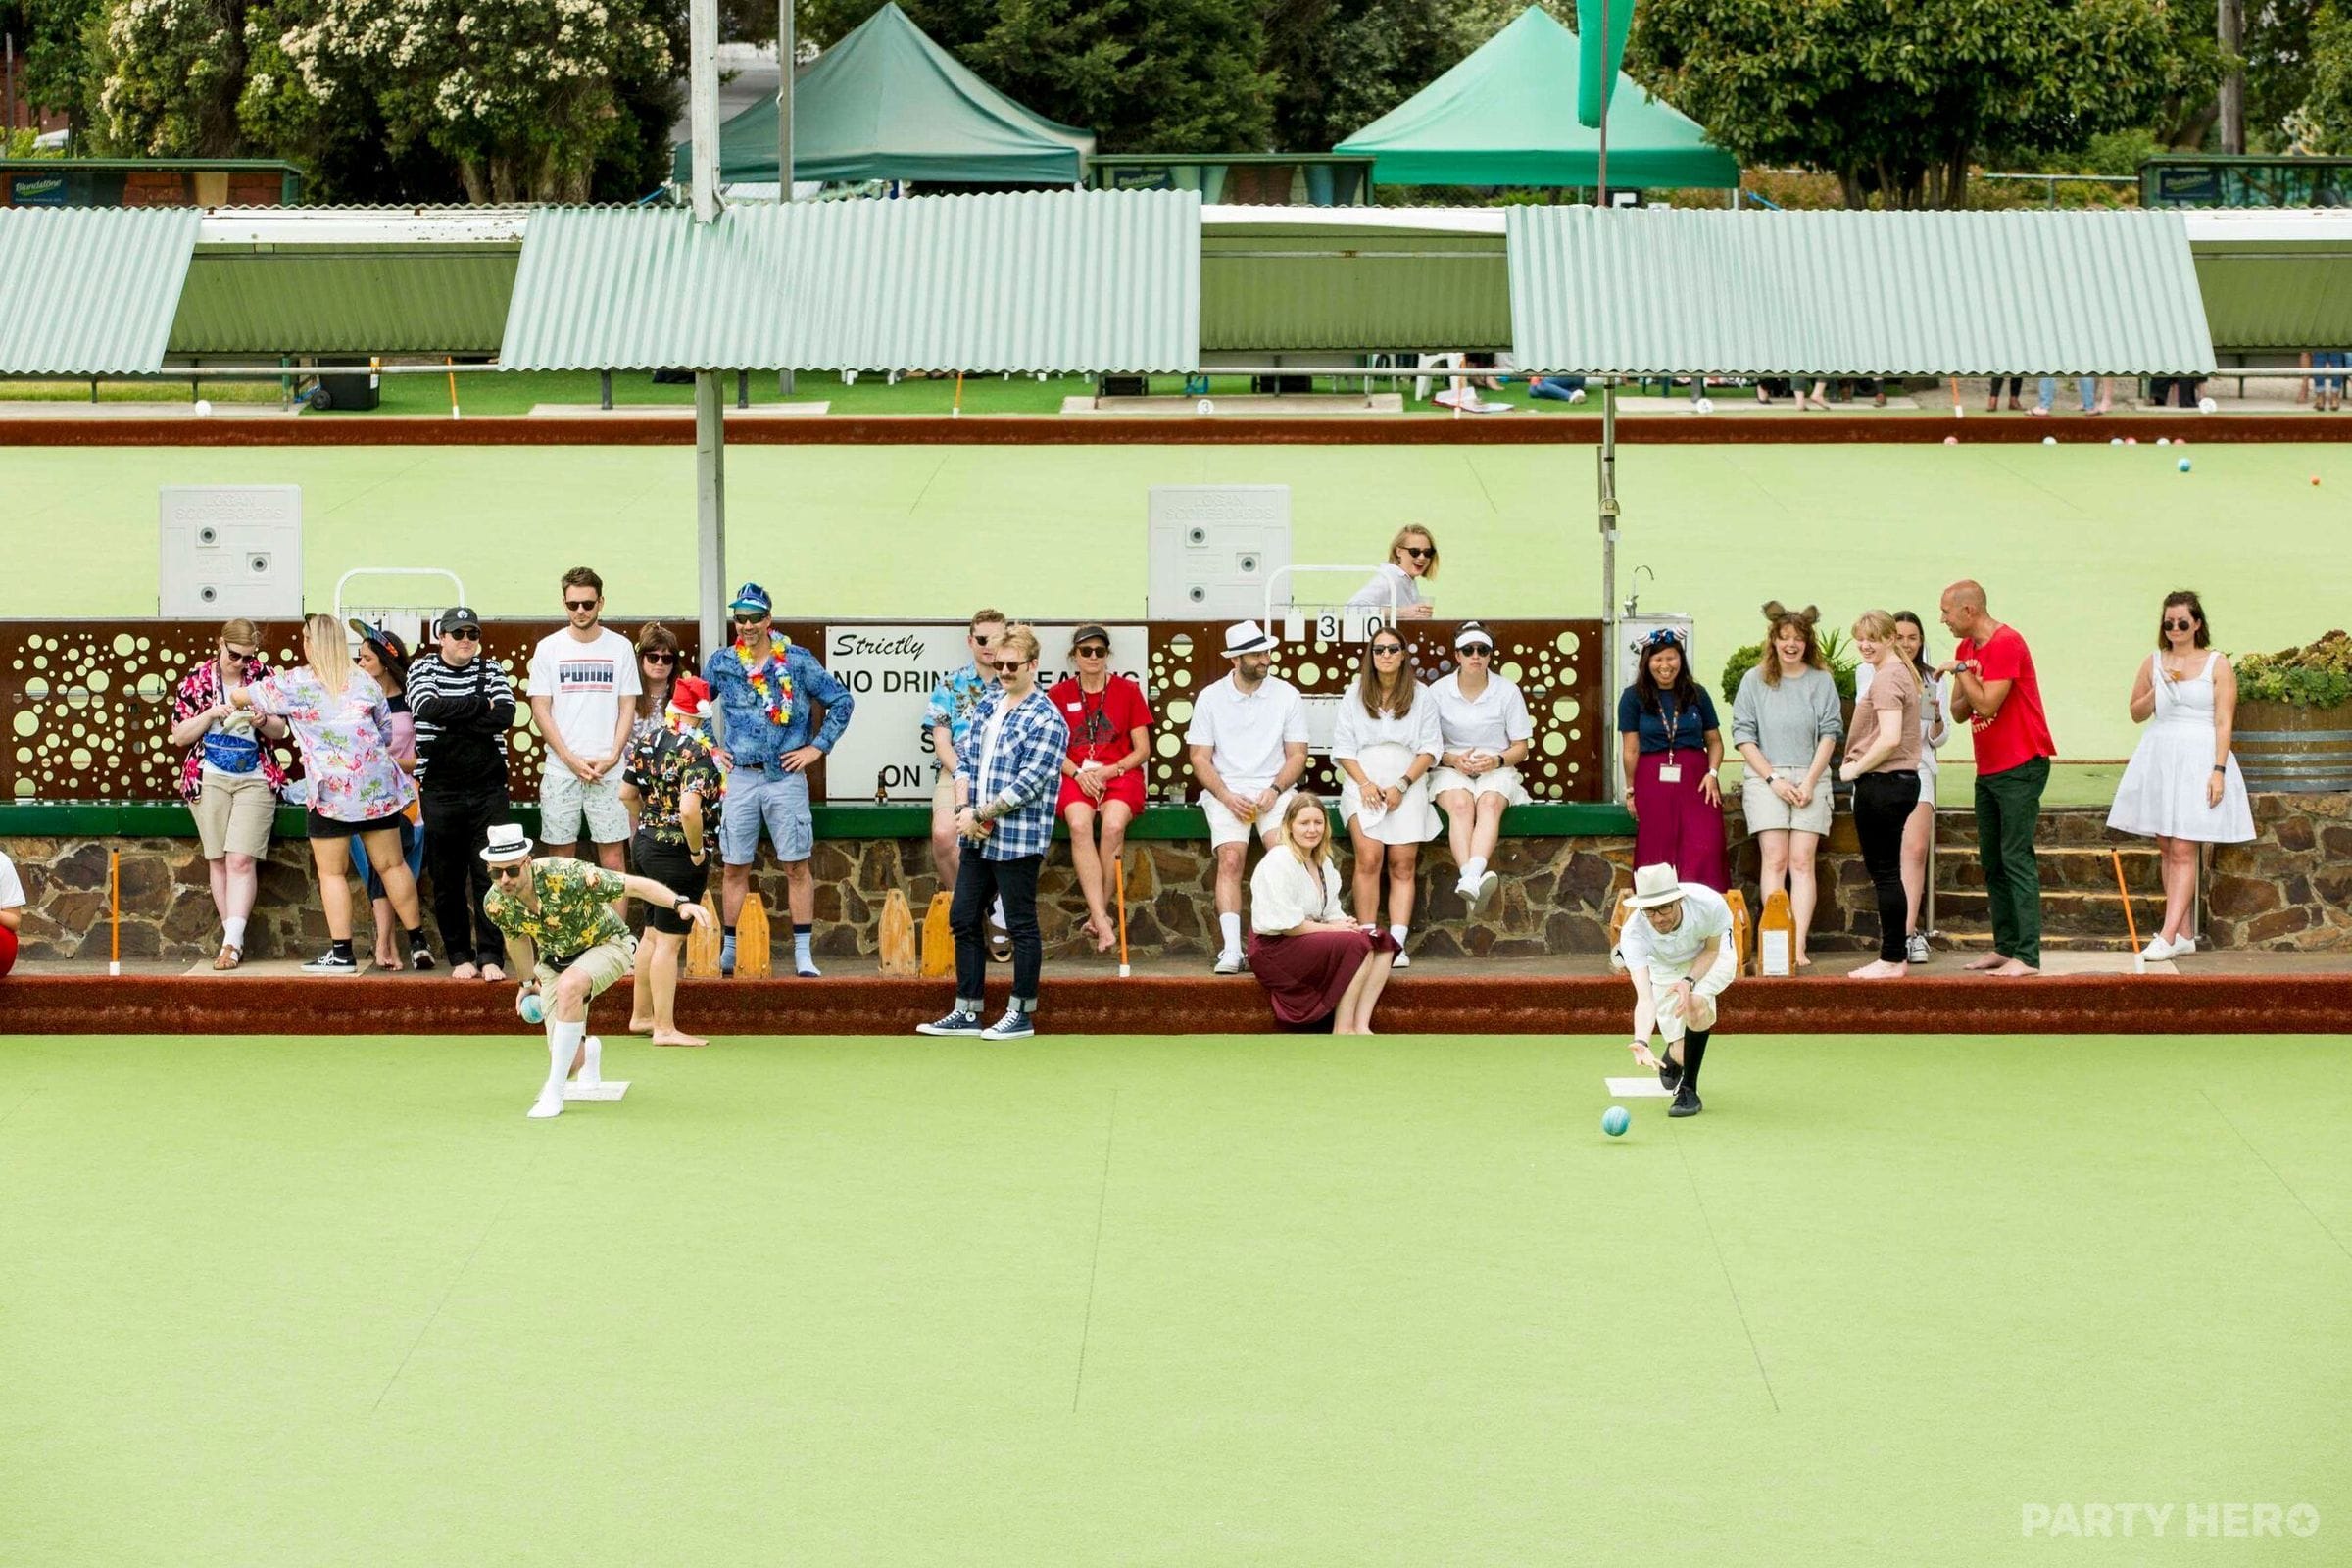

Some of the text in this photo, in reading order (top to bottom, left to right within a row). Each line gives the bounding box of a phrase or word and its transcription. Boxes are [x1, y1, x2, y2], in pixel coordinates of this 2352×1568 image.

[1320, 615, 1382, 638] 3 0
[832, 634, 925, 661] Strictly
[559, 663, 614, 683] PUMA
[833, 670, 873, 693] NO
[882, 765, 920, 788] ON
